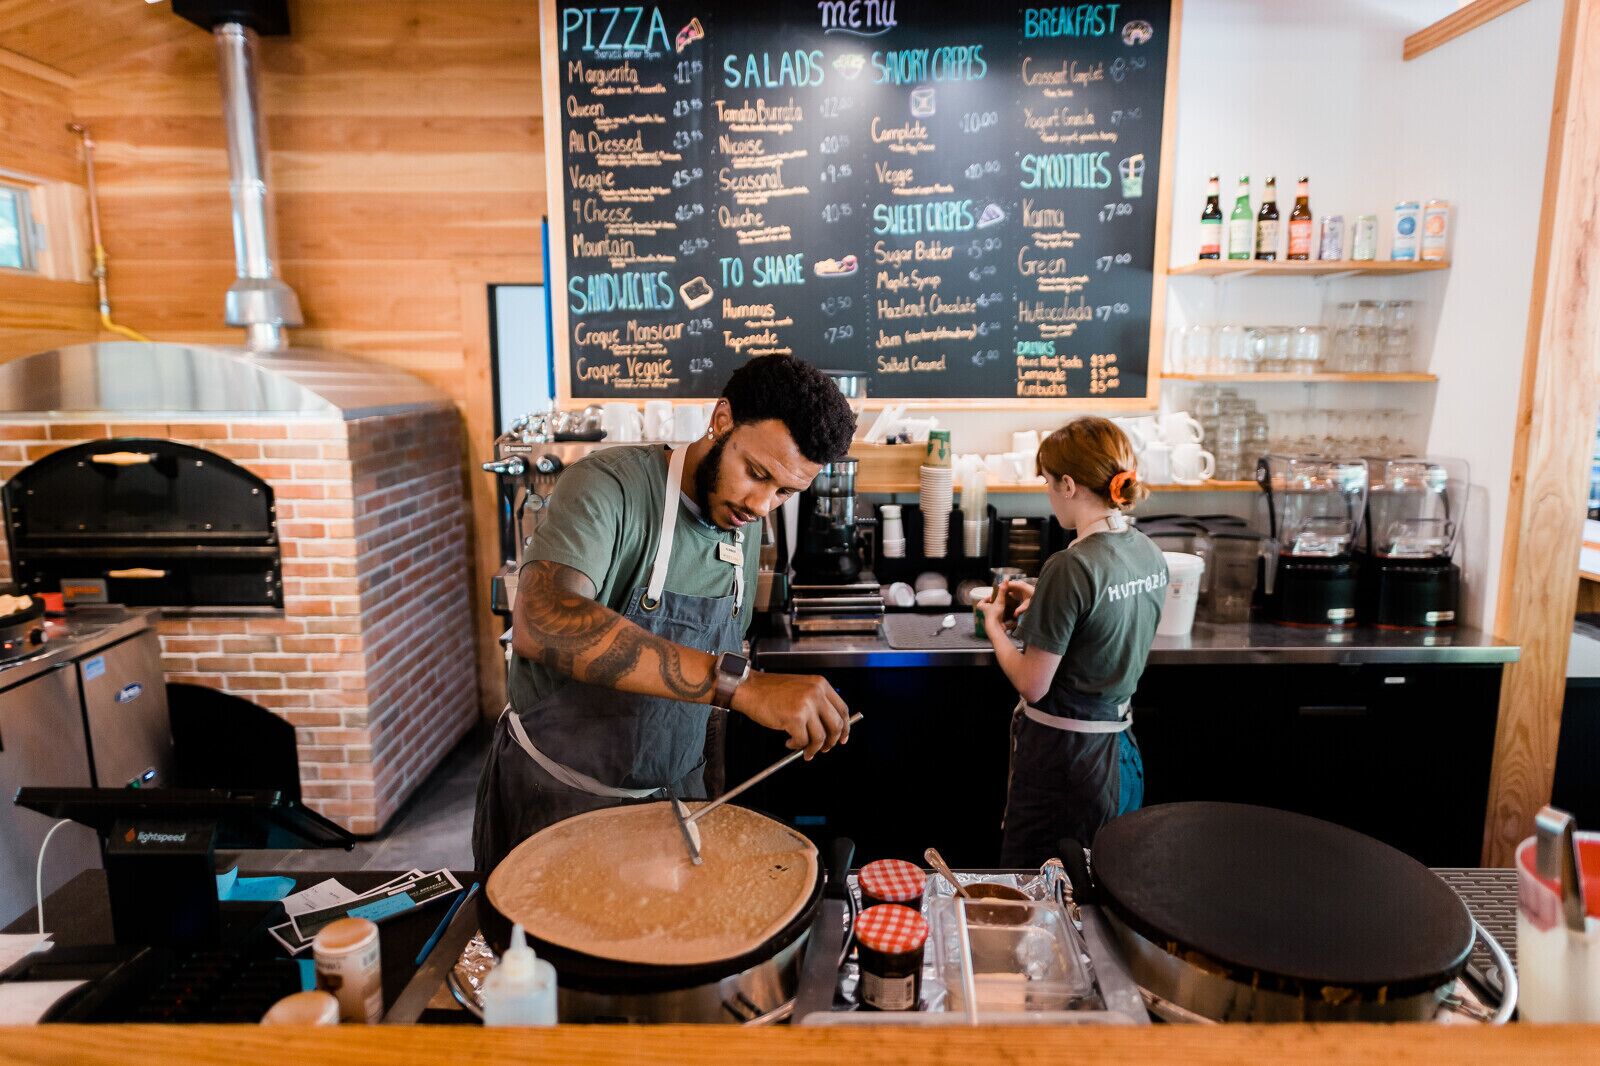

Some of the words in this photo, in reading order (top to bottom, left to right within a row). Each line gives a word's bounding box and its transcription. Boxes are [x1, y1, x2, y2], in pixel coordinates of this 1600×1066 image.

[562, 6, 671, 51] PIZZA
[1024, 4, 1121, 39] BREAKFAST
[723, 49, 825, 88] SALADS
[567, 95, 605, 118] Queen
[588, 130, 643, 152] Dressed
[569, 165, 616, 192] Veggie
[1019, 151, 1112, 190] SMOOTHIES
[584, 198, 633, 223] Cheese
[873, 203, 923, 236] SWEET
[719, 257, 744, 288] TO
[752, 253, 806, 288] SHARE
[1018, 245, 1067, 276] Green
[575, 322, 620, 350] Croque
[875, 329, 902, 349] Jam
[576, 357, 621, 385] Croque
[626, 356, 672, 382] Veggie
[138, 831, 186, 843] lightspeed
